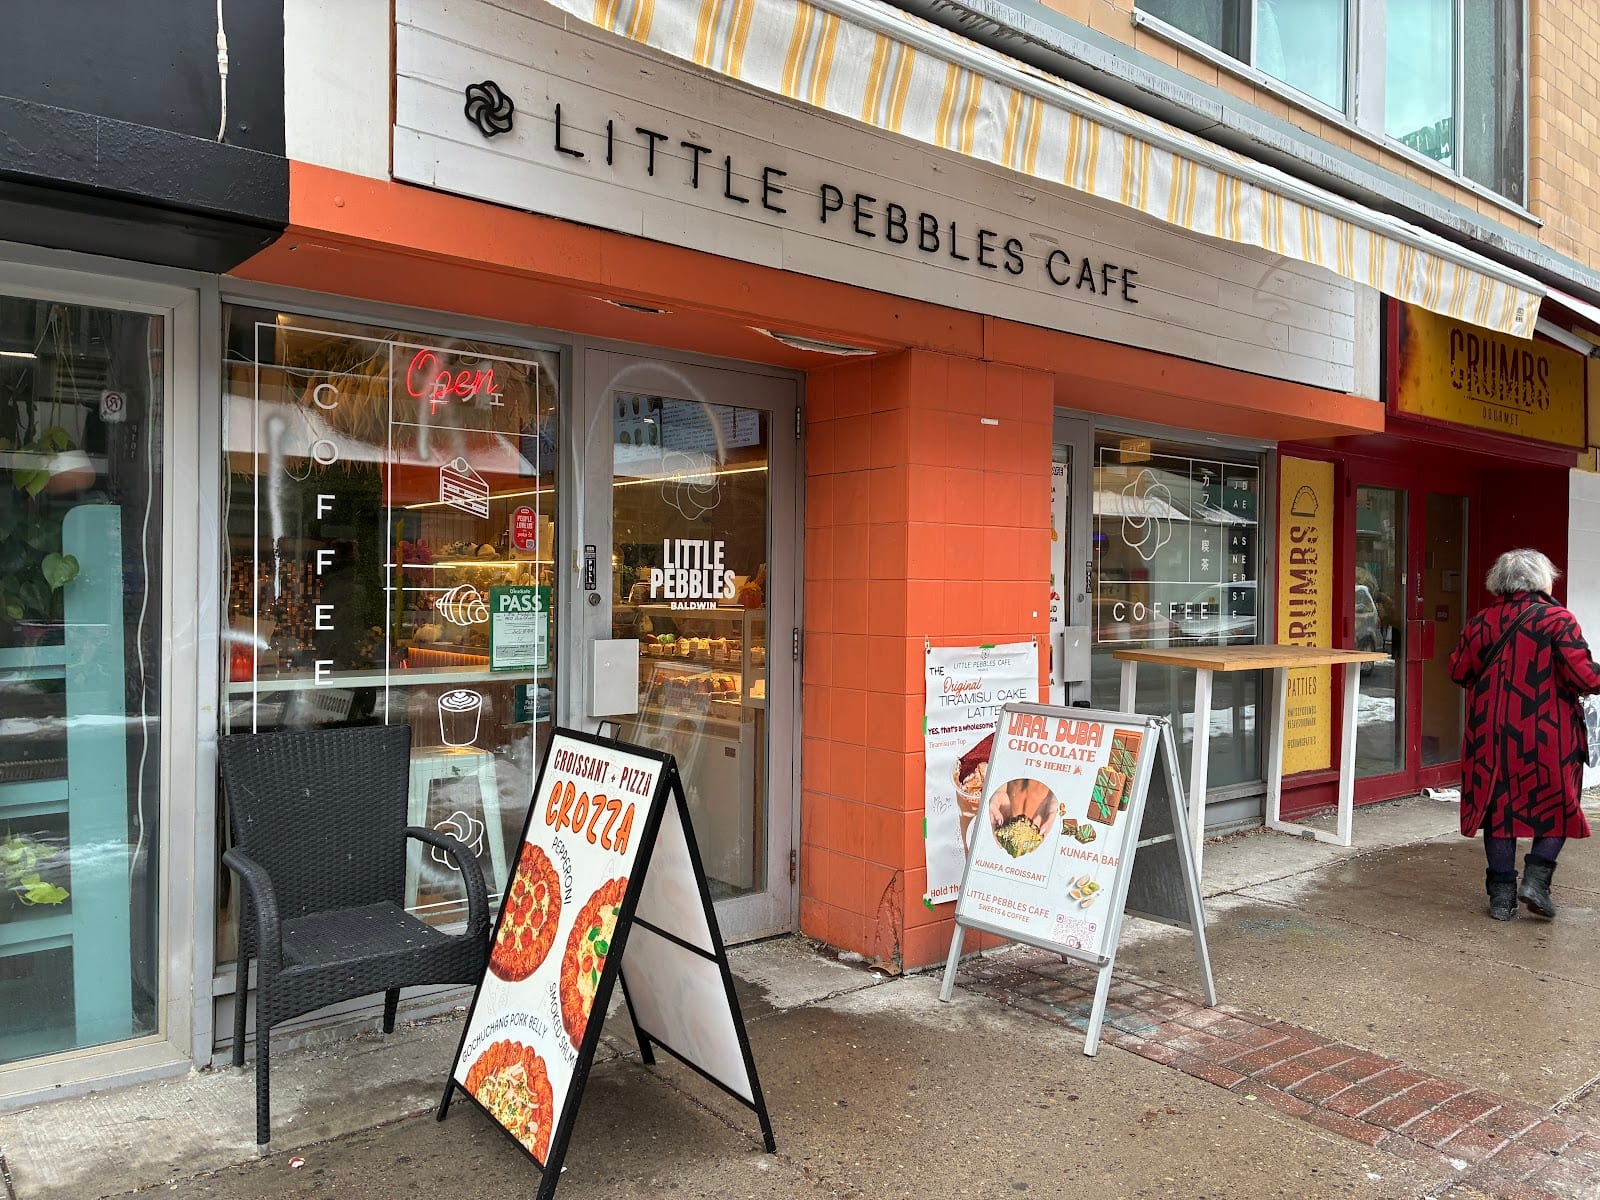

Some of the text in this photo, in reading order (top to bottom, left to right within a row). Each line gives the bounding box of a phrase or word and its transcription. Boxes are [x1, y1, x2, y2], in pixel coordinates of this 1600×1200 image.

[555, 103, 1138, 303] LITTLE PEBBLES CAFE
[1450, 327, 1550, 410] CRUMBS
[406, 349, 499, 415] Open
[313, 383, 339, 686] COFFEE
[663, 538, 725, 569] LITTLE
[650, 568, 736, 599] PEBBLES
[1289, 526, 1318, 647] RUMBS
[499, 594, 543, 612] PASS
[670, 601, 717, 610] BALDWIN
[1113, 602, 1209, 621] COFFEE
[929, 667, 945, 676] THE
[953, 661, 971, 669] LITTLE
[972, 660, 996, 668] PEBBLES
[938, 688, 1027, 707] TIRAMISU CAKE
[943, 676, 982, 697] Original
[1287, 676, 1317, 697] PATTIES
[967, 705, 1002, 719] LATTE
[963, 722, 993, 731] wholesome
[1008, 712, 1105, 748] VIRAL DUBAI
[1008, 738, 1097, 763] CHOCOLATE
[554, 748, 610, 783] CROISSANT
[619, 766, 653, 797] PIZZA
[1025, 758, 1072, 773] IT'S HERE!
[545, 780, 635, 856] CROZZA
[1060, 846, 1099, 863] KUNAFA
[552, 836, 573, 905] PEPPERONI
[975, 858, 1047, 883] KUNAFA CROISSANT
[930, 885, 961, 898] Hold th
[966, 889, 1051, 919] LITTLE PEBBLES CAFE
[978, 903, 1001, 915] SWEETS
[1007, 911, 1030, 923] COFFEE
[549, 982, 562, 1038] SMOKED
[462, 1012, 548, 1063] GOCHUCHANG PORK BELLY
